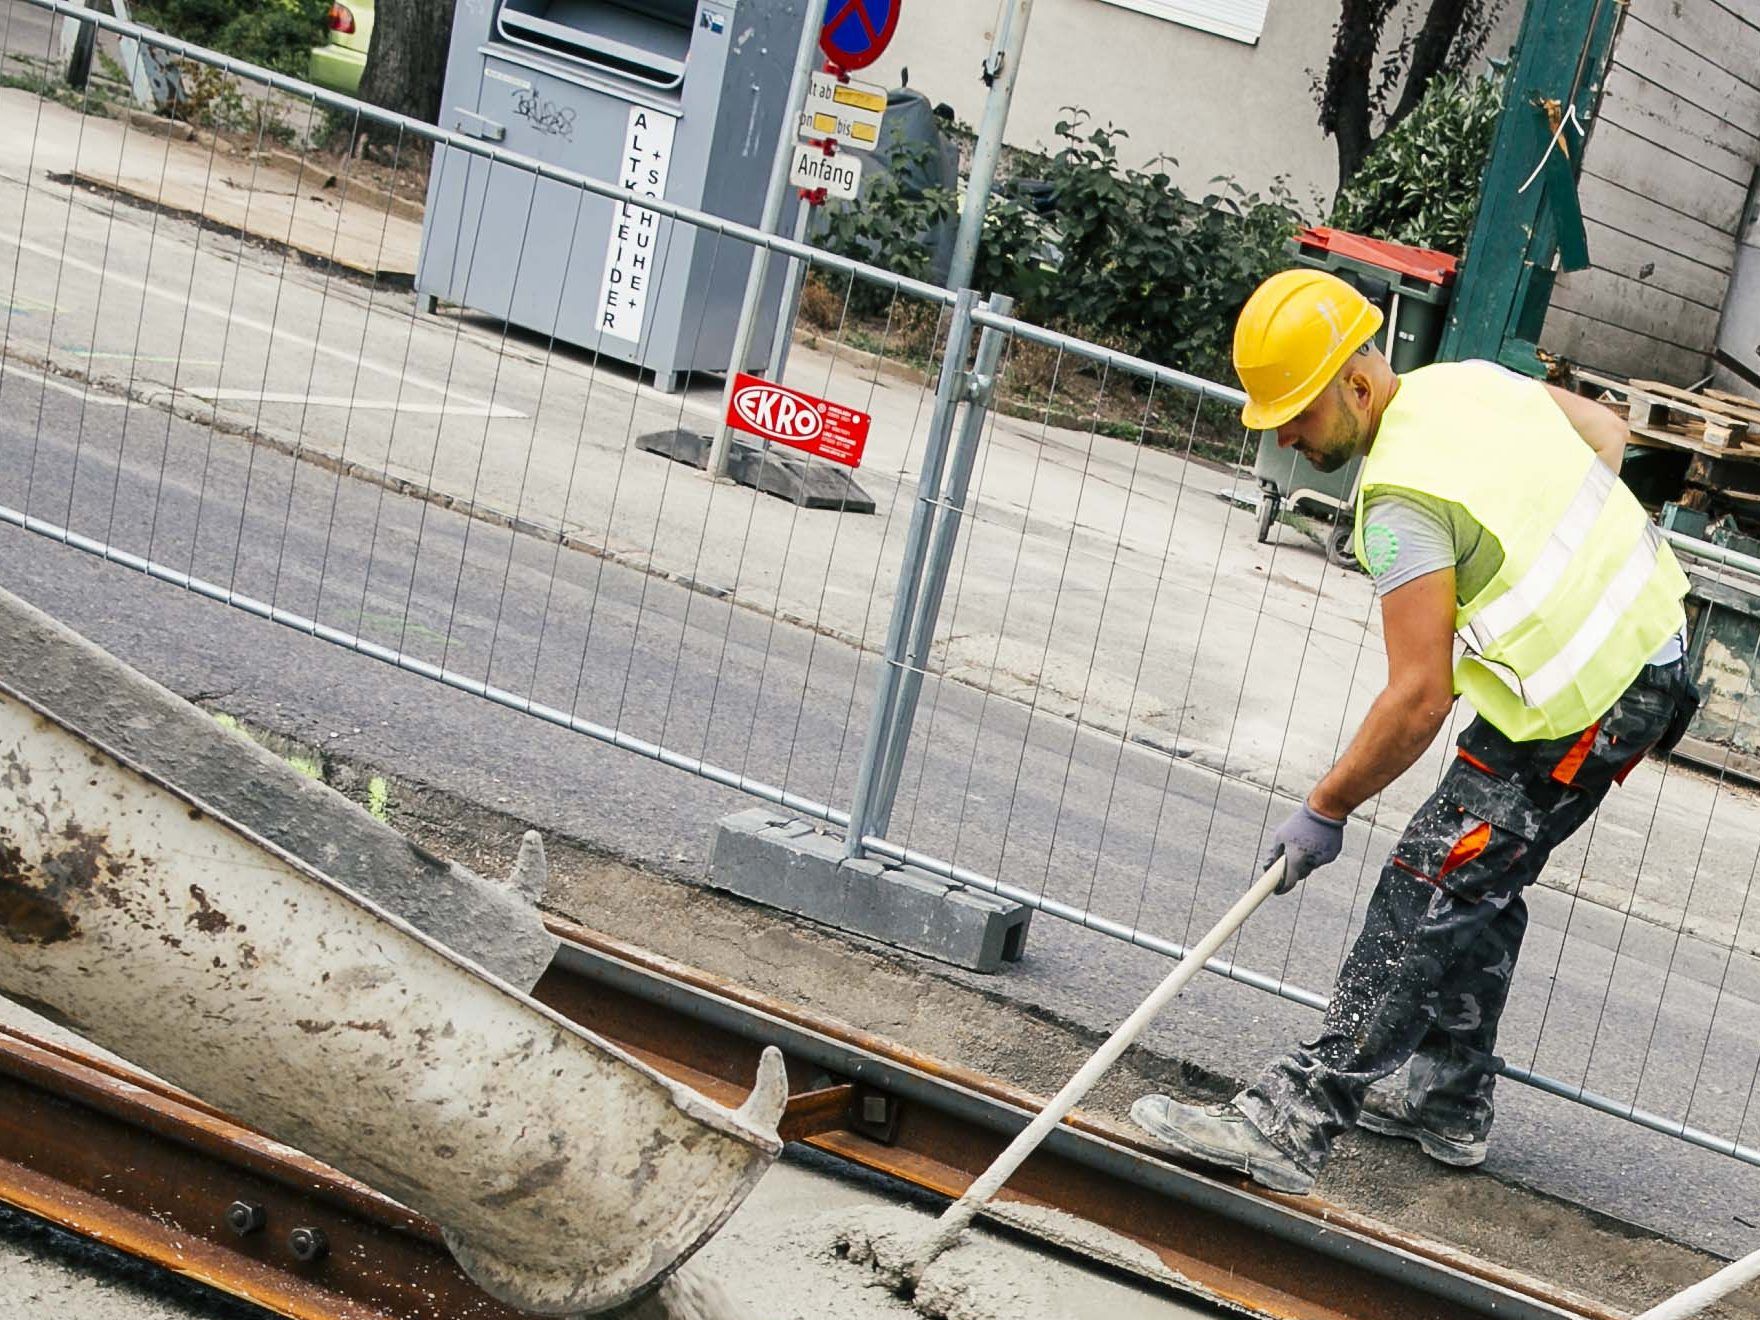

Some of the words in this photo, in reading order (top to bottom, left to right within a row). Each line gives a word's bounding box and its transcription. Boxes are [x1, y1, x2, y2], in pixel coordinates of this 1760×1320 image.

[819, 85, 832, 99] ab
[800, 112, 812, 127] on
[837, 119, 851, 136] bis
[798, 153, 854, 191] Anfang
[739, 390, 817, 435] EKRO
